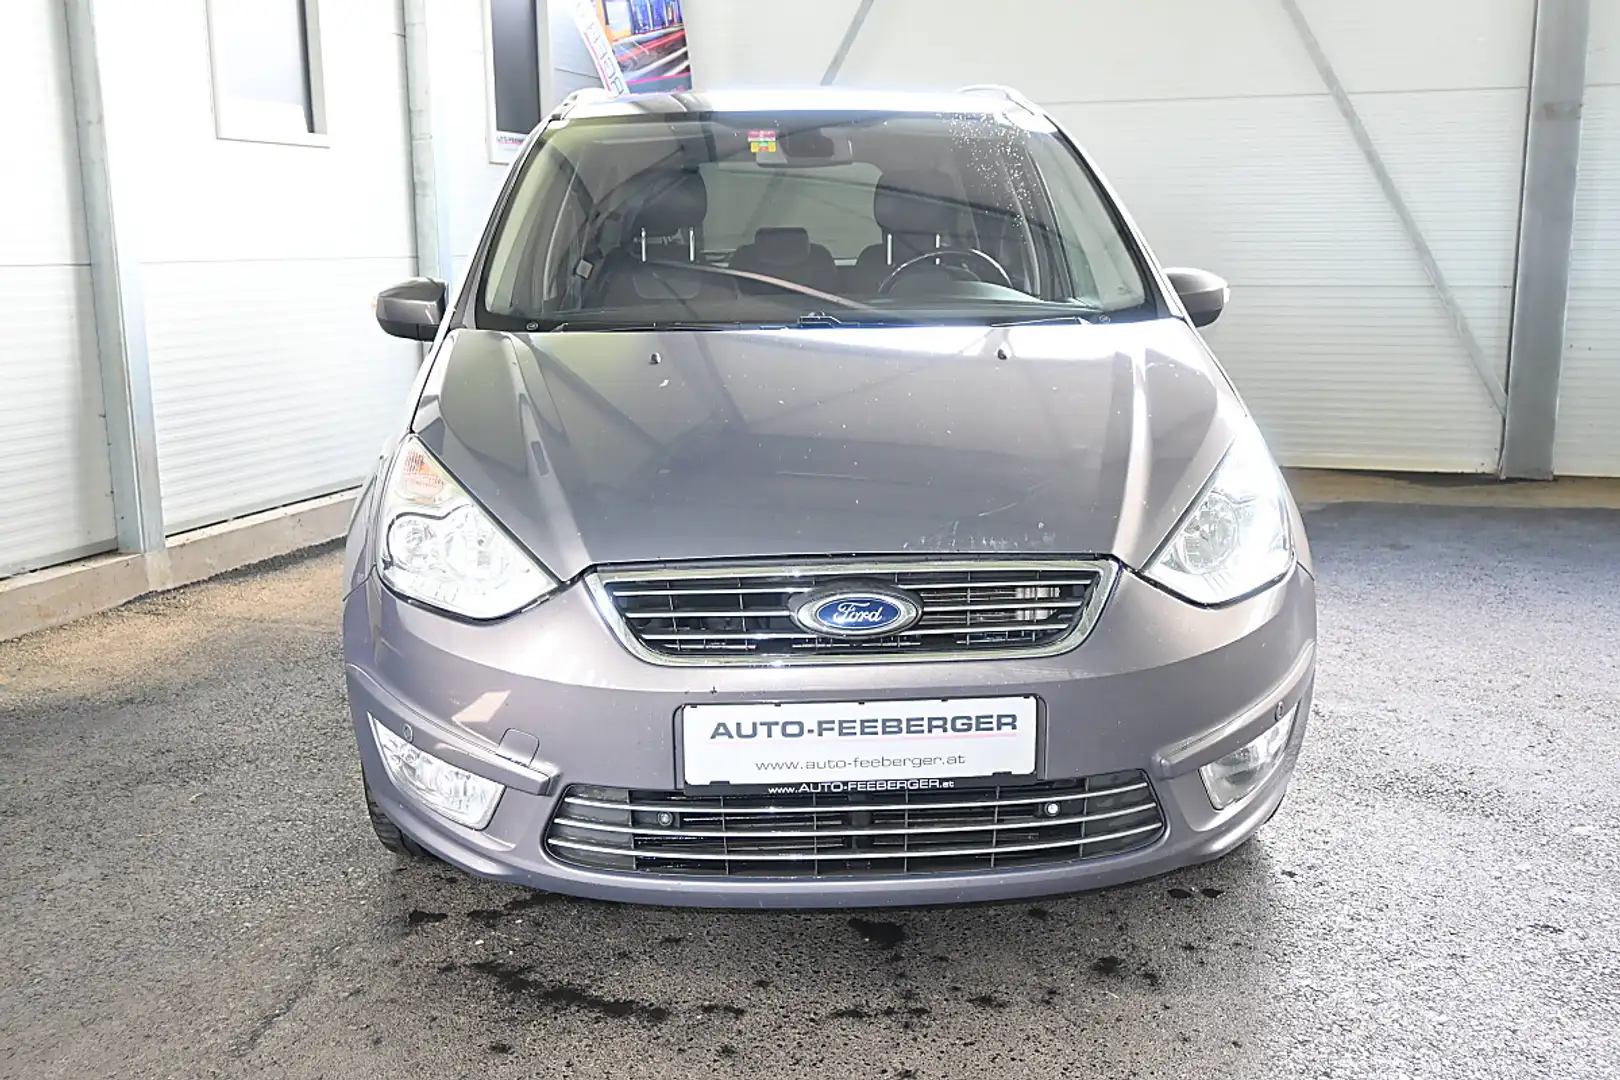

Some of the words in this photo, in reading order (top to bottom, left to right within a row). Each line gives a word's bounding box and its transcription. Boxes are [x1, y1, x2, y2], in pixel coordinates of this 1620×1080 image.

[833, 602, 883, 622] Ford
[710, 714, 1018, 739] AUTO-FEEBERGER
[756, 755, 966, 771] www.auto-feeberger.at
[767, 779, 955, 794] www.AUTO-FEEBERGER.at
